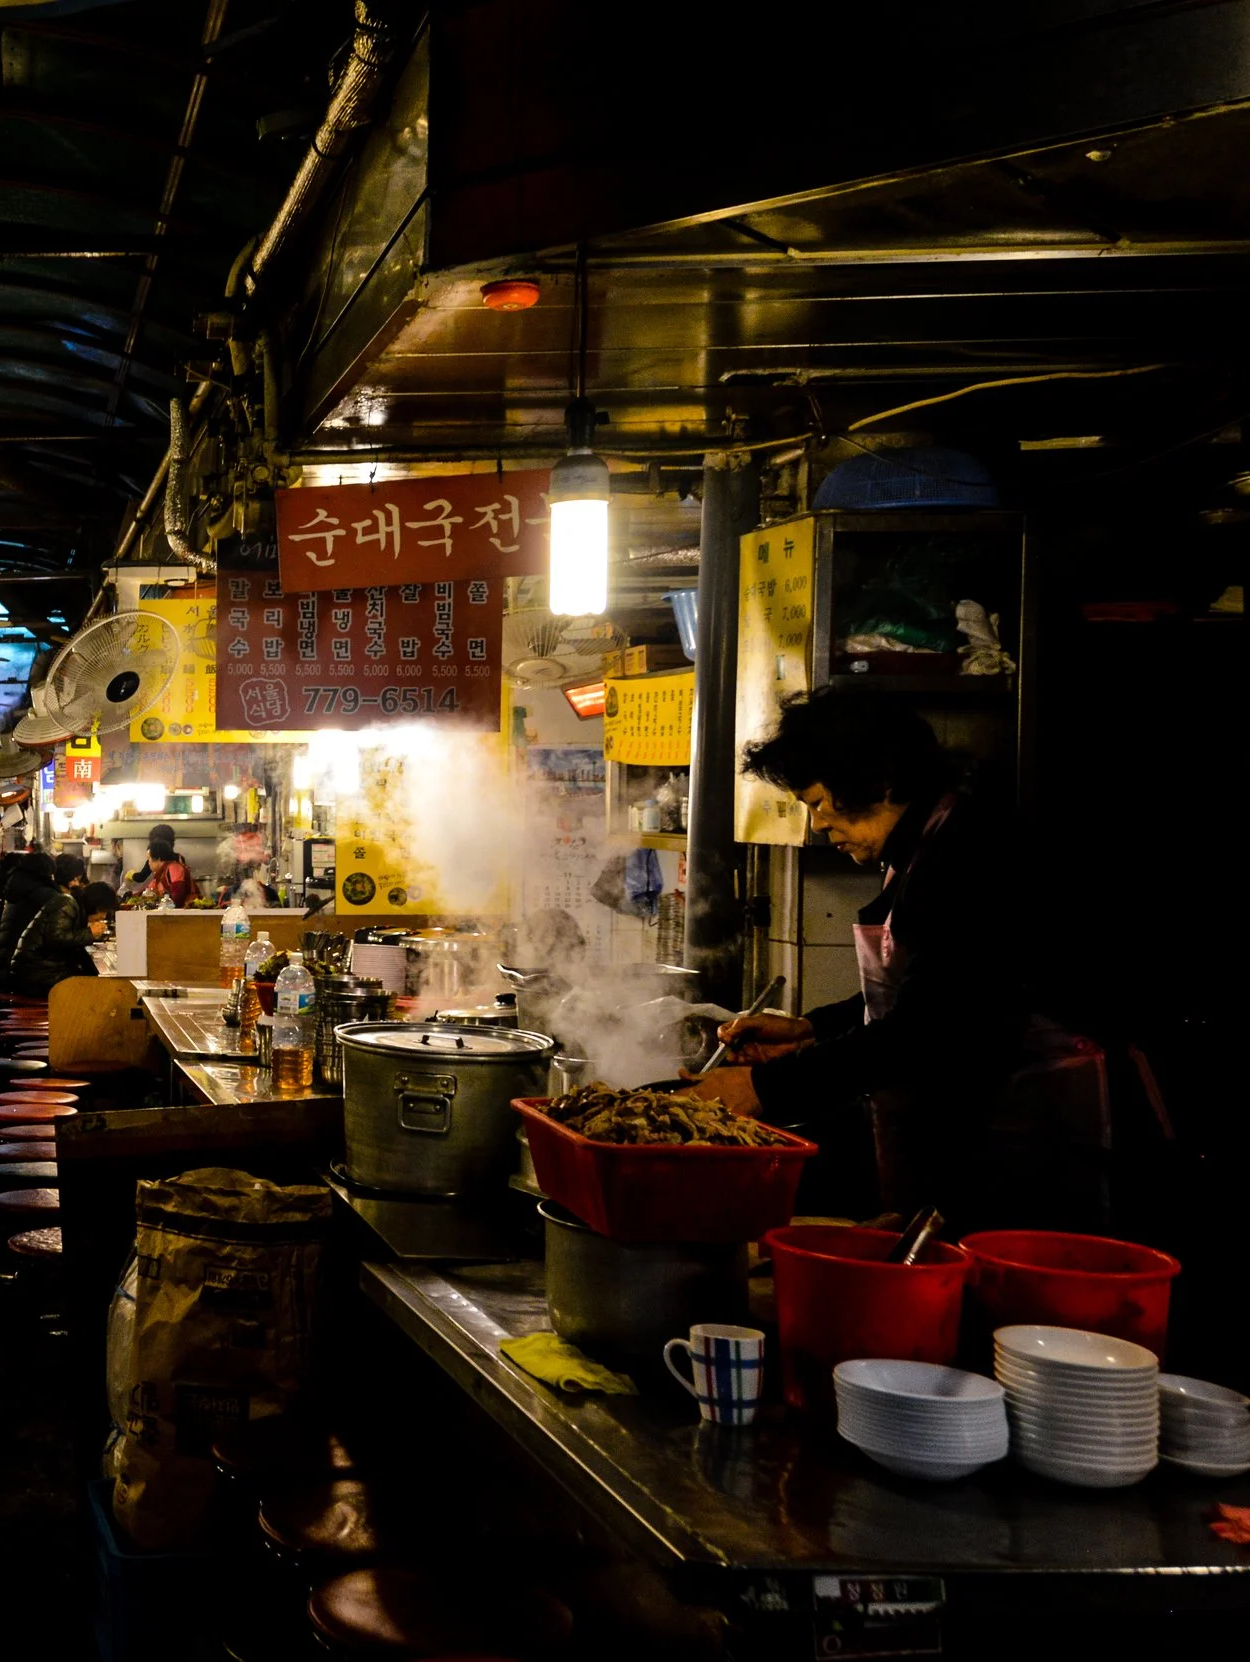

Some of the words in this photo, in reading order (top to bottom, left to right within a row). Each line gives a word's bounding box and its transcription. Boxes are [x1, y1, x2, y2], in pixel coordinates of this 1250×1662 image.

[229, 578, 249, 659] 칼국수
[263, 580, 283, 659] 보리밥
[299, 588, 318, 660] 빔냉면
[433, 581, 453, 660] 비빔국수
[468, 582, 489, 660] 쫄면
[260, 663, 286, 676] 5,500
[295, 663, 321, 676] 5,500
[329, 663, 354, 676] 5,500
[363, 663, 389, 676] 5,000
[303, 686, 460, 714] 779-6514
[73, 758, 92, 779] 南
